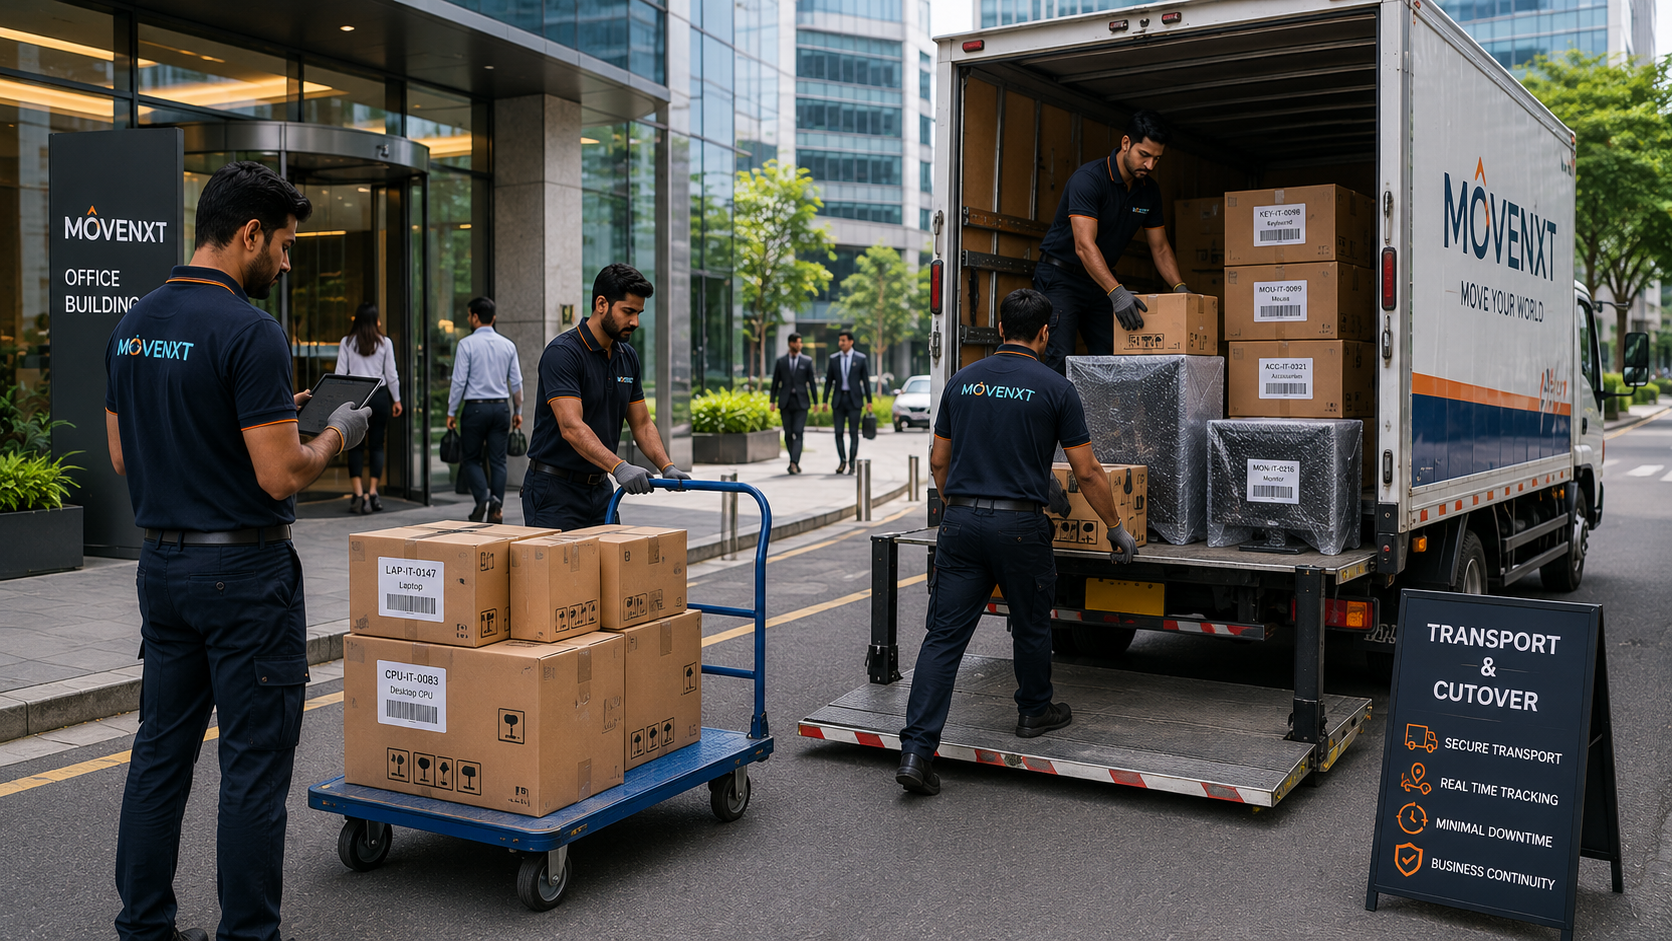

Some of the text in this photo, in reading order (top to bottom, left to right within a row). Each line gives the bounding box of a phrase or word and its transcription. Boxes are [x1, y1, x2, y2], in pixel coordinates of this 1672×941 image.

[64, 268, 121, 287] OFFICE
[1460, 280, 1544, 323] MOVE YOUR WORLD
[385, 565, 437, 578] LAP-IT-0147
[399, 581, 423, 592] Laptop
[1427, 623, 1561, 655] TRANSPORT
[385, 669, 439, 686] CPU-IT-0083
[1480, 656, 1496, 677] &
[418, 689, 433, 700] CPU
[1433, 680, 1539, 712] CUTOVER
[1444, 737, 1563, 765] SECURE TRANSPORT
[1440, 777, 1559, 806] REAL TIME TRACKING
[1436, 817, 1553, 848] MINIMAL DOWNTIME
[1431, 857, 1556, 891] BUSINESS CONTINUITY
